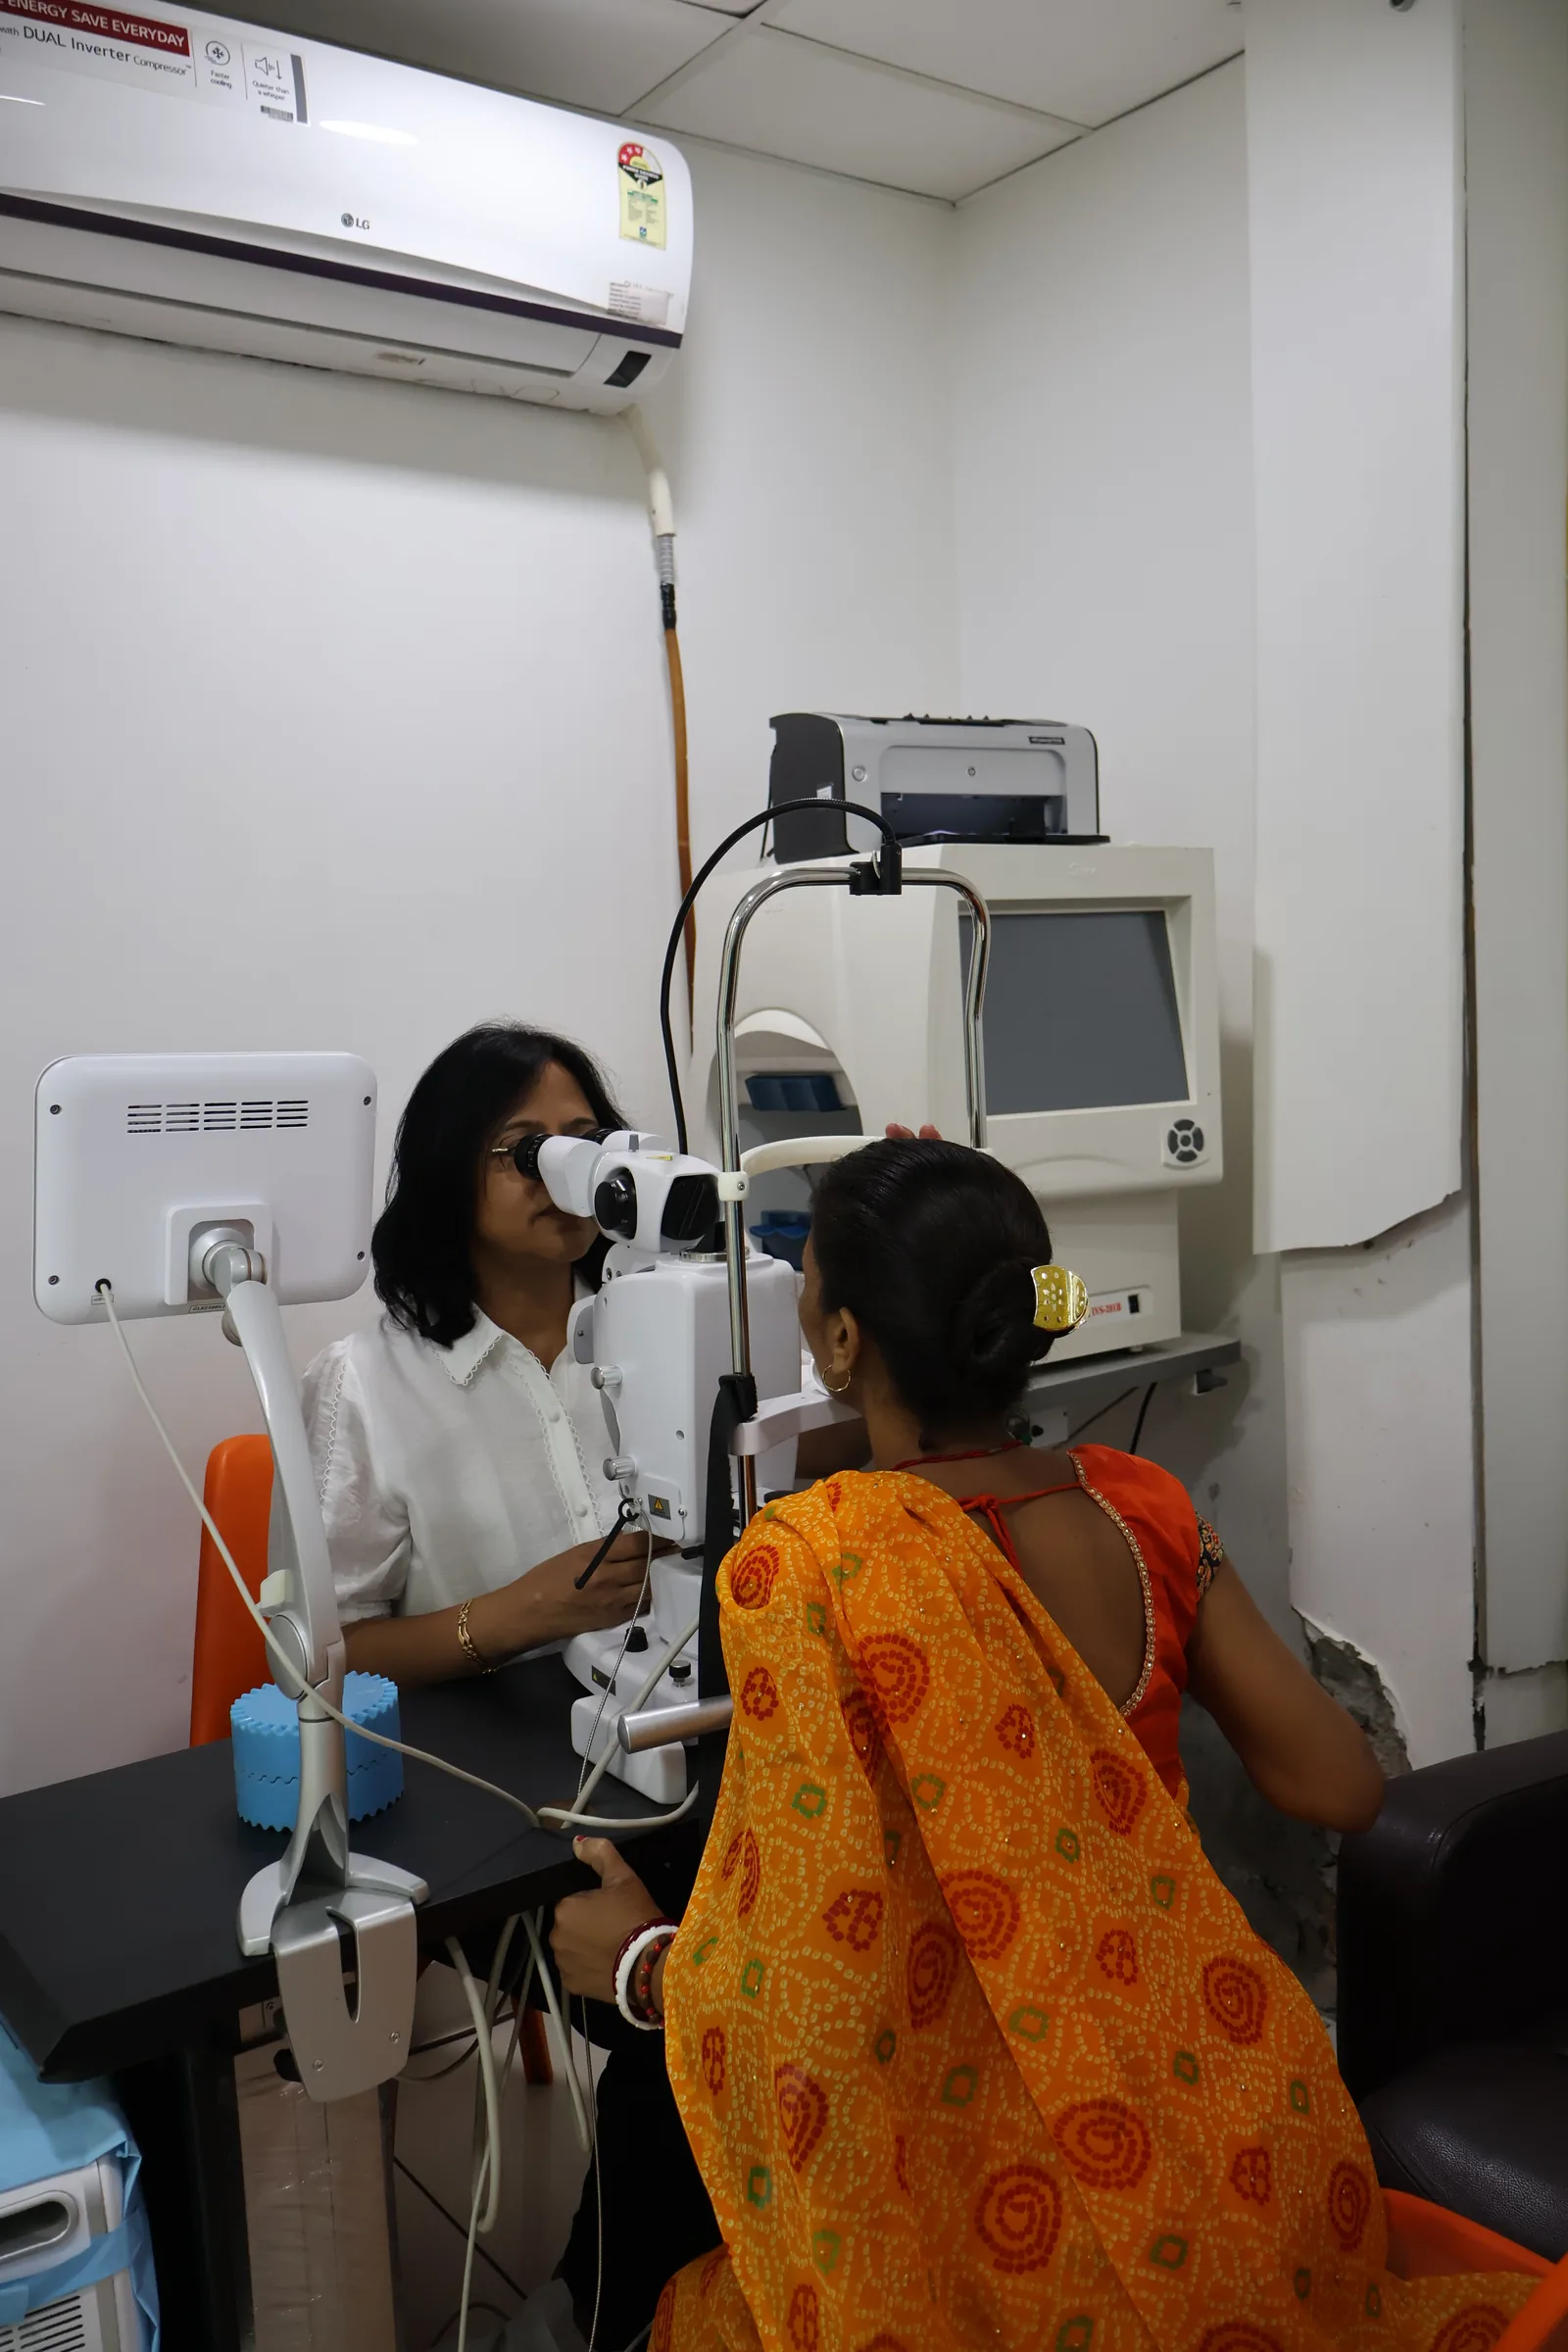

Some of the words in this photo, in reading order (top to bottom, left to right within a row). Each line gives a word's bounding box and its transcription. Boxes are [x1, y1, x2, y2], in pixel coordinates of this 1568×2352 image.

[8, 0, 68, 19] ENERGY
[71, 9, 109, 29] SAVE
[112, 19, 185, 48] EVERYDAY
[0, 26, 20, 36] with
[24, 25, 67, 48] DUAL
[71, 37, 130, 62] Inverter
[211, 70, 230, 79] Faster
[210, 78, 232, 90] cooling
[252, 79, 273, 90] Quieter
[275, 86, 290, 95] than
[262, 90, 285, 101] whisper
[356, 218, 370, 230] LG
